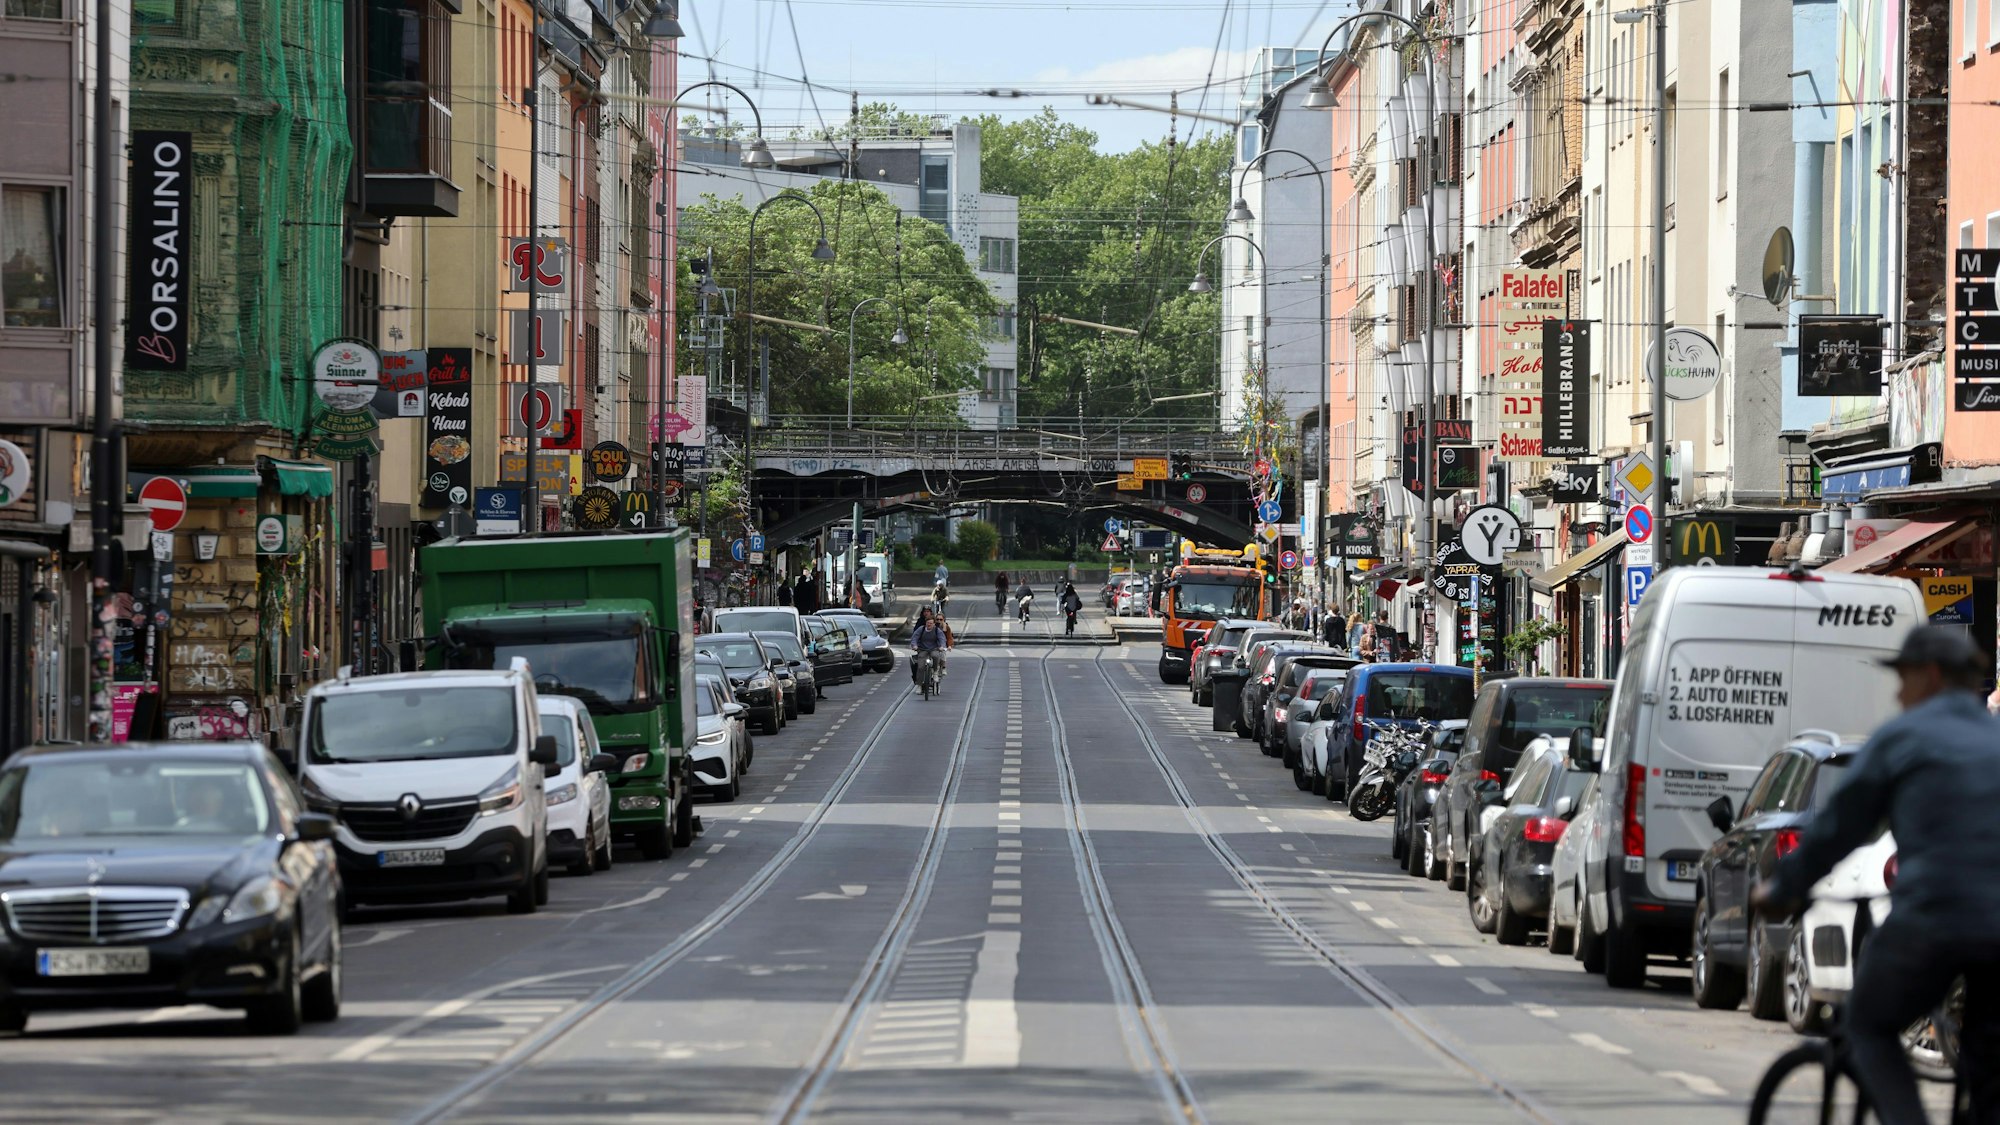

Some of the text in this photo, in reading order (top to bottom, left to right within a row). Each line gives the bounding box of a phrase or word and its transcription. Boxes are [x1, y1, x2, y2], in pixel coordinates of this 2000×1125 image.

[137, 141, 181, 364] BORSALINO
[1503, 273, 1563, 298] Falafel
[326, 364, 367, 377] Sünner
[1664, 365, 1715, 378] ÜCKSHUHN
[1961, 358, 2000, 370] MUSI
[428, 392, 470, 410] Kebab
[320, 420, 373, 432] KLEINMANN
[328, 414, 365, 425] BEI OMA
[432, 415, 467, 431] Haus
[1419, 421, 1472, 439] CBANA
[1501, 432, 1543, 456] Schawa
[592, 449, 628, 463] SOUL
[652, 446, 684, 461] GROS
[506, 458, 553, 473] SPEL
[595, 462, 624, 475] BAR
[664, 461, 679, 469] ITA
[1557, 472, 1593, 495] sky
[753, 537, 762, 550] P
[1346, 545, 1373, 555] KIOSK
[1444, 565, 1481, 575] YAPRAK
[1434, 574, 1493, 600] DÖNR
[1630, 570, 1647, 601] P
[1928, 584, 1967, 596] CASH
[1818, 603, 1897, 627] MILES
[1671, 666, 1783, 687] 1. APP ÖFFNEN
[1669, 686, 1788, 707] 2. AUTO MIETEN
[1668, 704, 1775, 725] 3. LOSFAHREN
[1678, 863, 1688, 877] B
